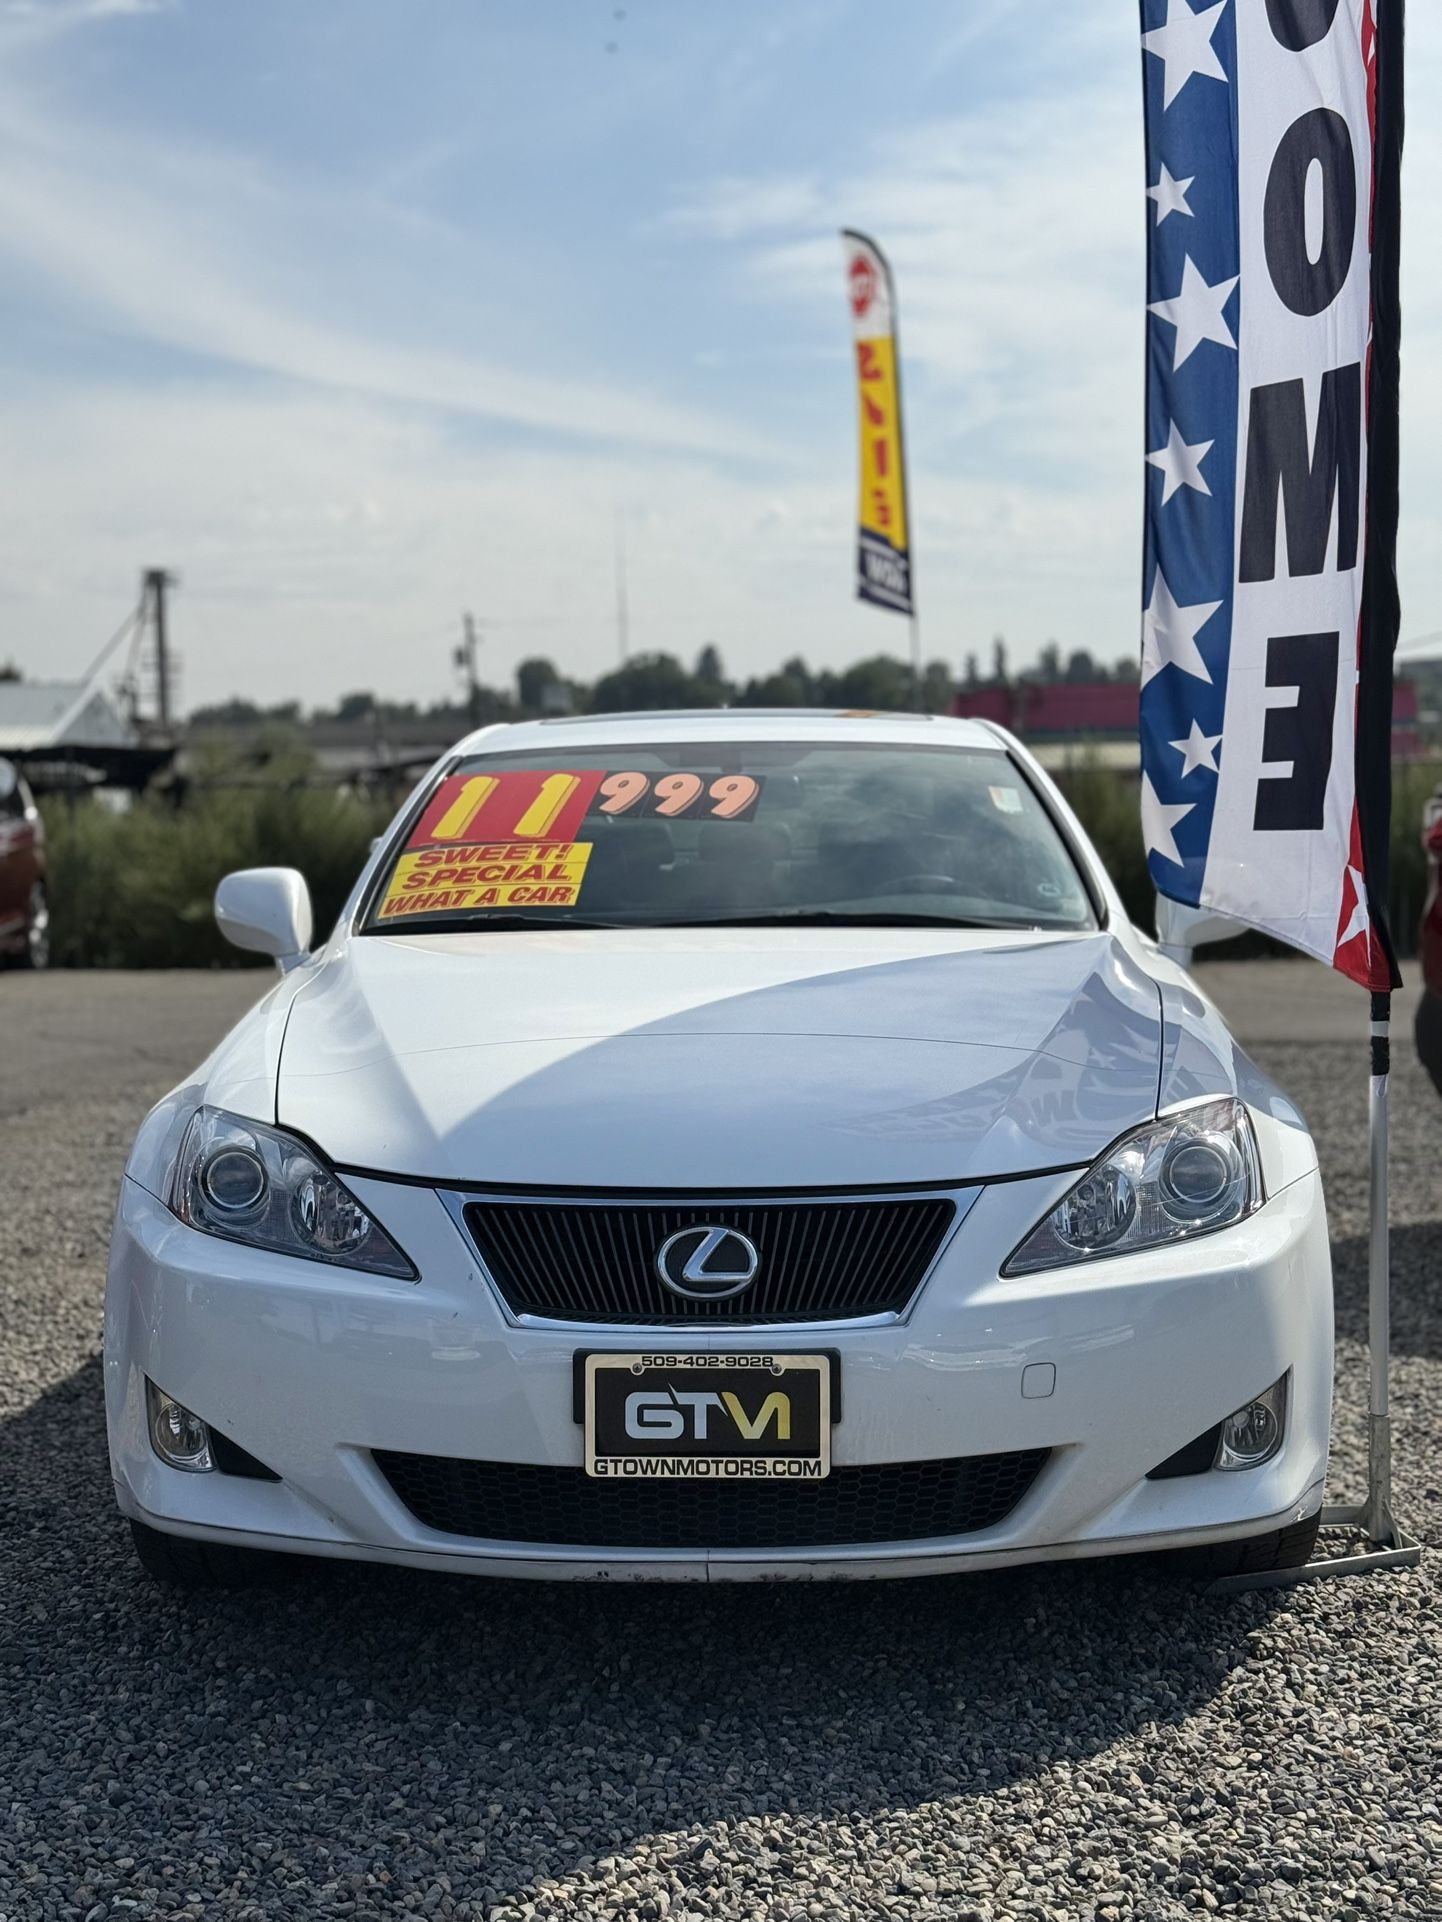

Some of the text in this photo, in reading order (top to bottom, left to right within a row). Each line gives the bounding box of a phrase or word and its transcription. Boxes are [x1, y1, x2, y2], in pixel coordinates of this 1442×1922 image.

[599, 771, 759, 819] 999
[414, 844, 574, 869] SWEET!
[402, 863, 571, 891] SPECIAL
[383, 886, 576, 916] WHAT A CAR
[641, 1356, 774, 1368] 509-402-9028
[625, 1381, 791, 1440] GTM
[593, 1458, 822, 1477] GTOWNMOTORS.COM
